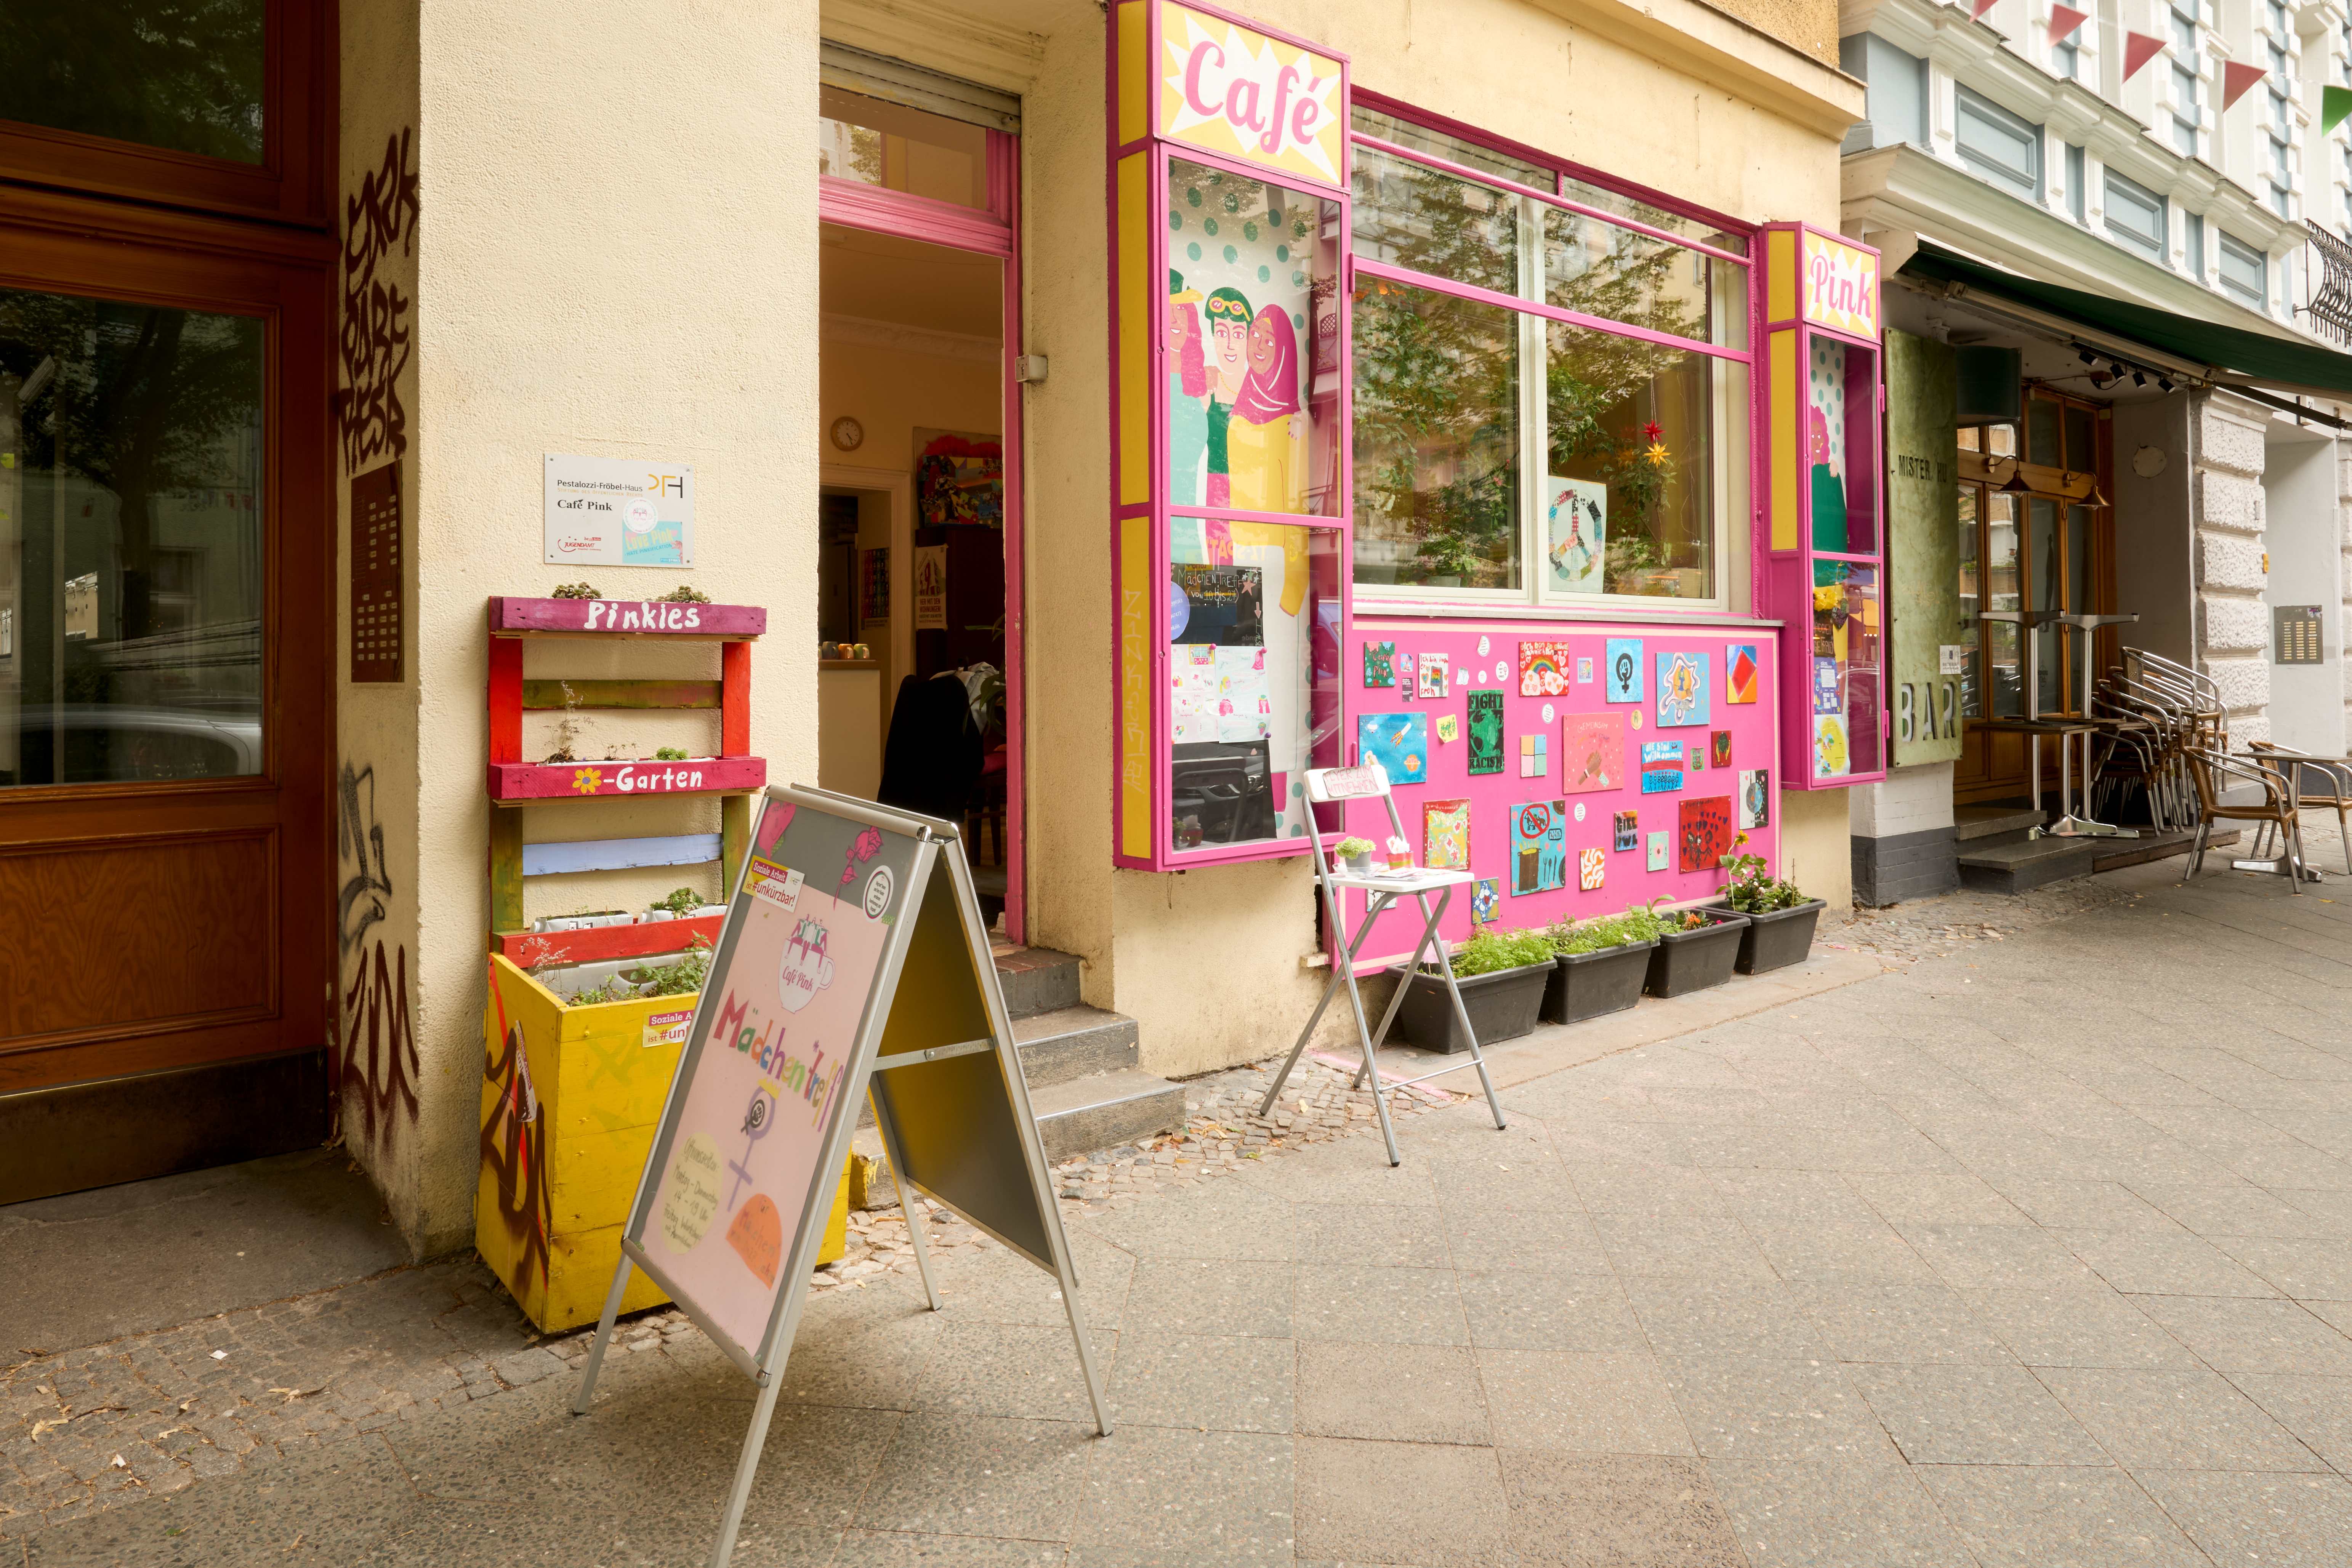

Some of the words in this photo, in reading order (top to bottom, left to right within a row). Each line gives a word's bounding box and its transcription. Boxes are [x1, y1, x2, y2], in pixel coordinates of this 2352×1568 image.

[1185, 40, 1322, 155] Café
[1810, 255, 1872, 318] Pink
[1899, 455, 1930, 480] MISTER
[558, 480, 642, 492] Pestalozzi-Fröbel-Haus
[558, 499, 583, 509] Café
[587, 501, 612, 511] Pink
[584, 601, 700, 630] Pinkies
[1469, 693, 1504, 709] FIGHT
[1902, 682, 1956, 742] BAR
[1325, 769, 1352, 781] FLYER
[1328, 779, 1379, 794] MITNEHMEN
[753, 862, 770, 875] Soziale
[770, 869, 785, 882] Arbeit
[752, 879, 796, 907] #unkürzbar!
[782, 966, 798, 986] Café
[796, 972, 814, 991] Pink
[651, 1014, 683, 1025] Soziale
